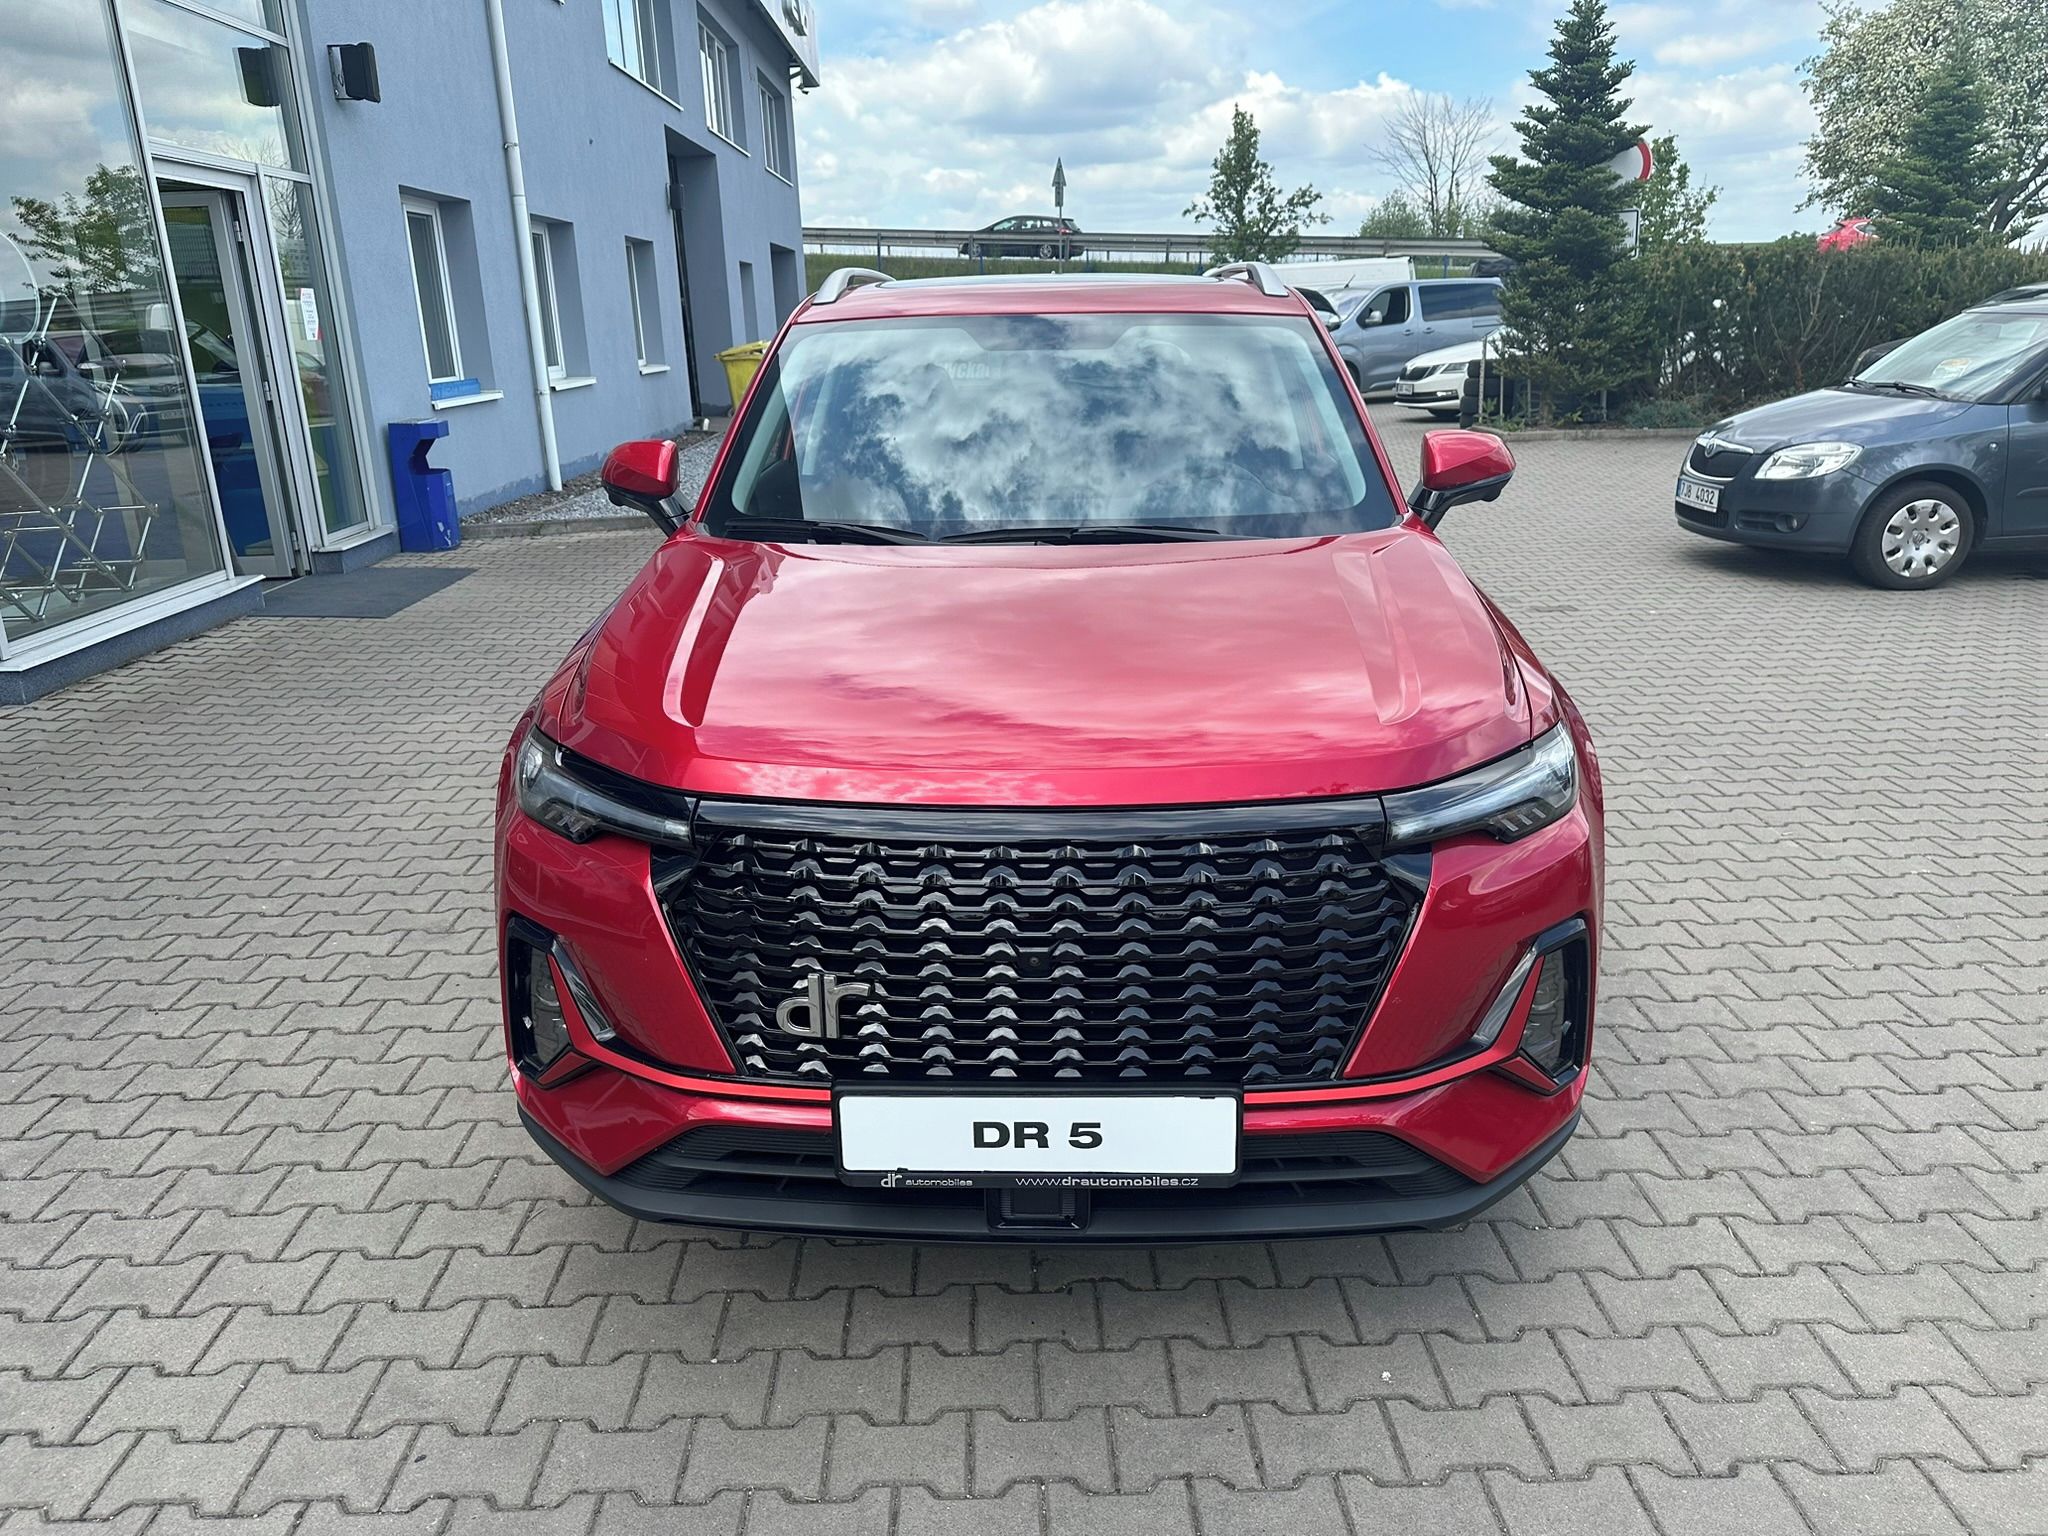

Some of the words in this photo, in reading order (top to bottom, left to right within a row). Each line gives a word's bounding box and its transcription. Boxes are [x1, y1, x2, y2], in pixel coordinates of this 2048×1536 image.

[1695, 487, 1715, 505] 4032
[776, 973, 871, 1039] dr
[972, 1121, 1050, 1149] DR
[1067, 1121, 1103, 1149] 5
[880, 1173, 903, 1188] dr
[905, 1178, 973, 1187] automobiles
[1015, 1176, 1200, 1187] www.drautomobiles.cz
